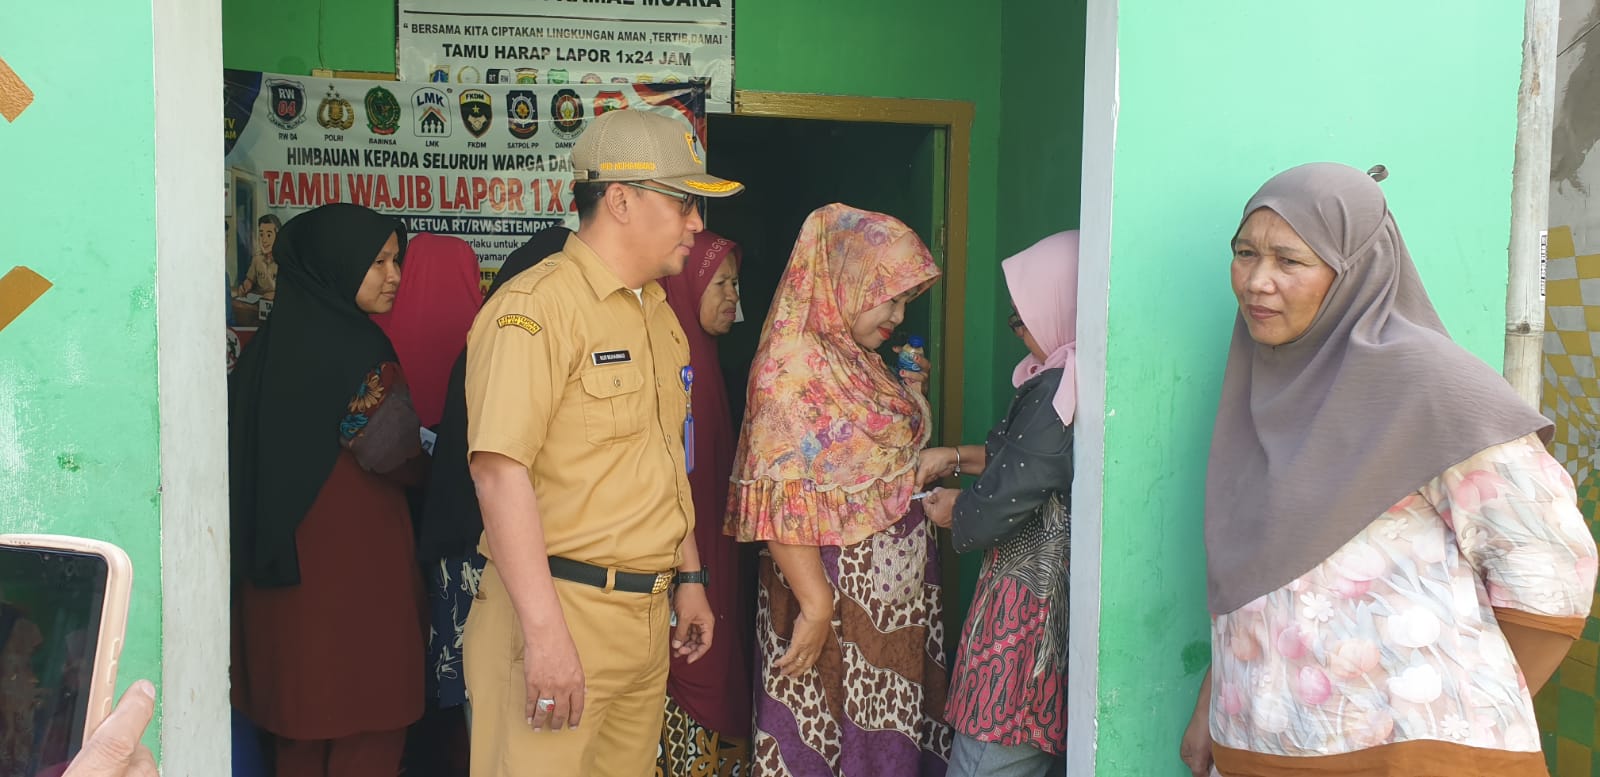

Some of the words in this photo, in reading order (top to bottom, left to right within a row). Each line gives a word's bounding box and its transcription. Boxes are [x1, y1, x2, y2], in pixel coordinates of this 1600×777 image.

[411, 23, 461, 35] BERSAMA
[464, 25, 489, 36] KITA
[491, 26, 544, 38] CIPTAKAN
[547, 28, 614, 40] LINGKUNGAN
[617, 31, 646, 42] AMAN
[442, 43, 489, 58] TAMU
[494, 45, 551, 60] HARAP
[556, 47, 611, 63] LAPOR
[616, 50, 653, 64] 1x24
[659, 51, 691, 66] JAM
[278, 88, 295, 99] RW
[416, 92, 445, 108] LMK
[465, 93, 485, 101] FKDM
[277, 100, 297, 117] 04
[324, 134, 344, 142] POLRI
[368, 138, 397, 146] BABINSA
[287, 147, 360, 167] HIMBAUAN
[364, 149, 419, 169] KEPADA
[423, 152, 488, 171] SELURUH
[492, 154, 545, 172] WARGA
[263, 170, 341, 206] TAMU
[347, 173, 432, 209] WAJIB
[439, 175, 524, 212] LAPOR
[530, 178, 541, 212] 1
[410, 217, 449, 232] KETUA
[452, 219, 492, 233] RT/RW
[494, 239, 518, 248] untuk
